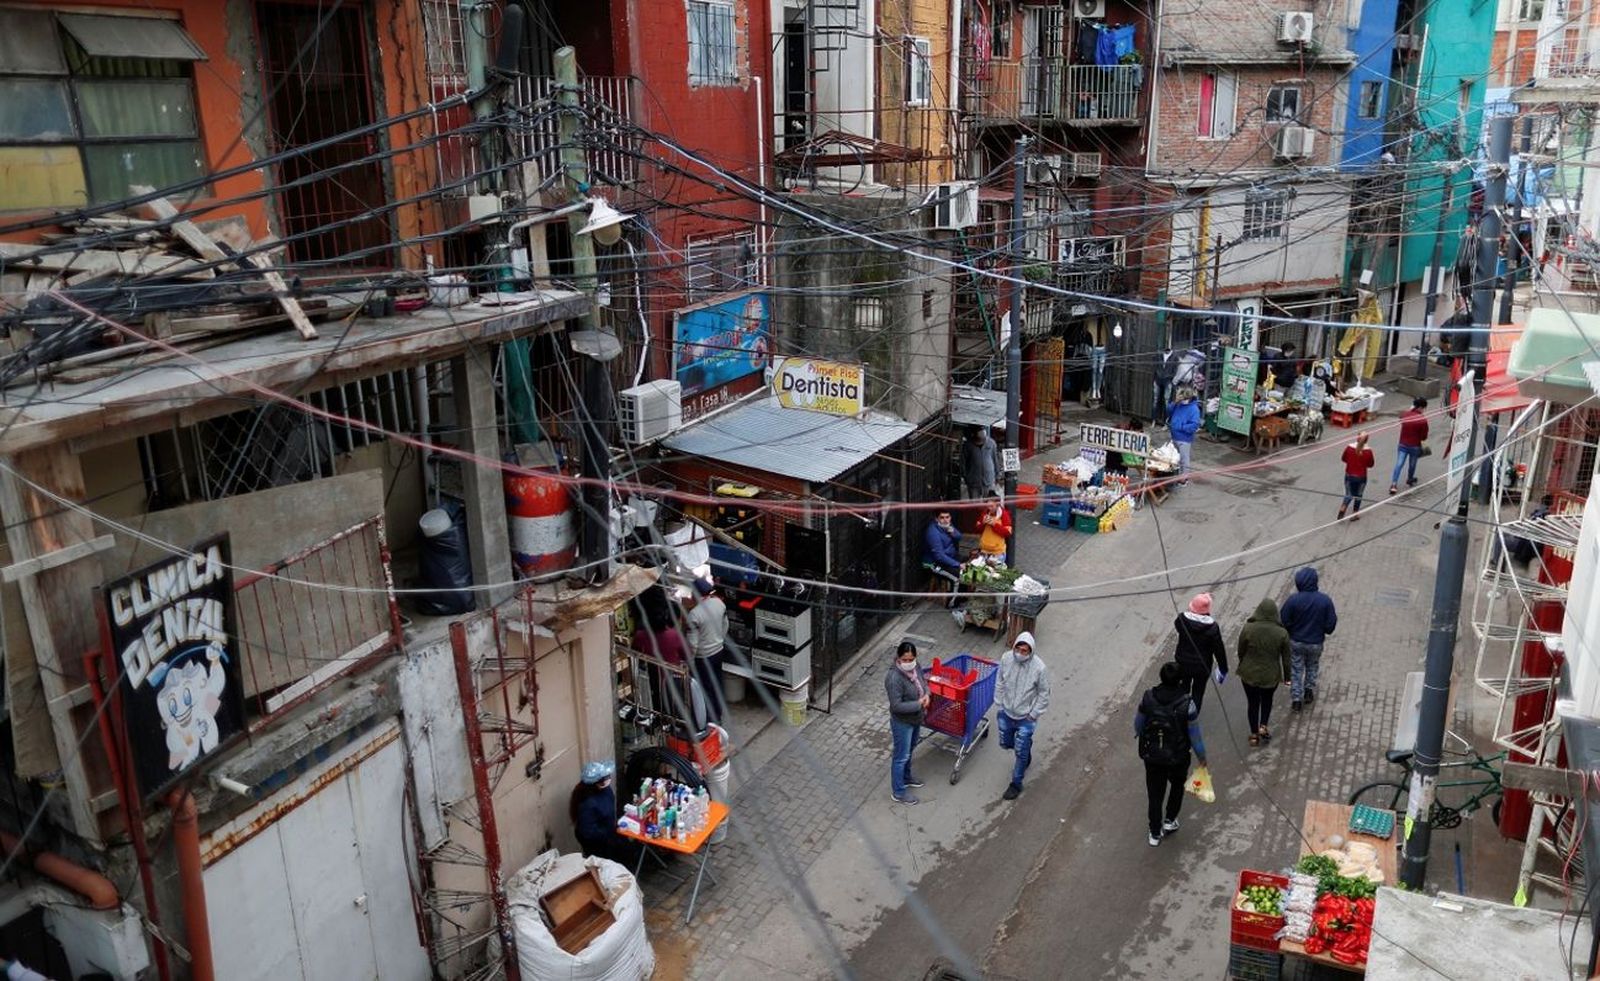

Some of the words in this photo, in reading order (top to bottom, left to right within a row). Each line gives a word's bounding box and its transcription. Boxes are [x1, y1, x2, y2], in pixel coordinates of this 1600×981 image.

[782, 371, 858, 400] Dentista
[1080, 425, 1148, 452] FERRETERIA
[110, 545, 223, 626] CLINICA
[122, 598, 228, 690] DENTAL
